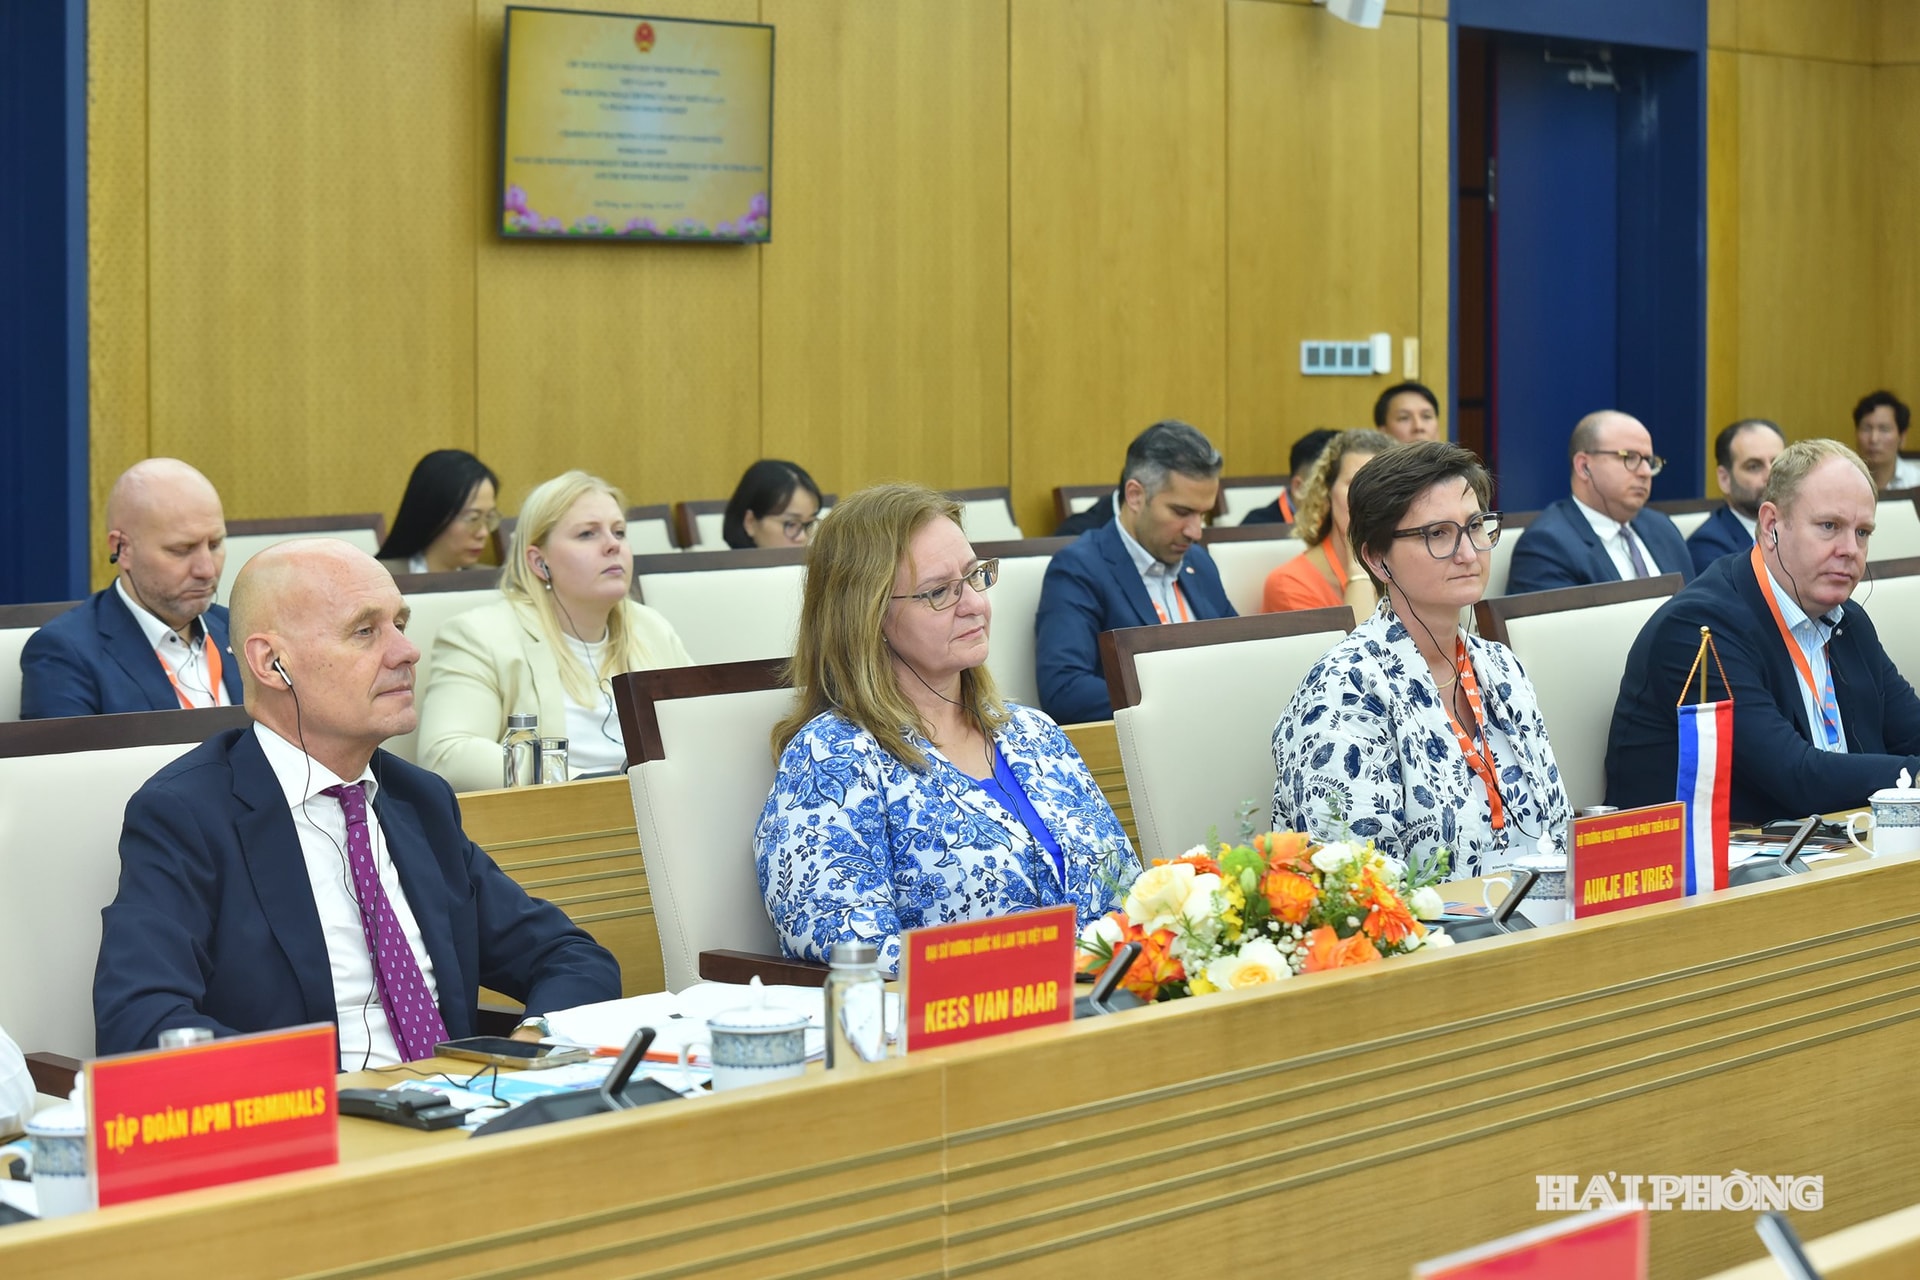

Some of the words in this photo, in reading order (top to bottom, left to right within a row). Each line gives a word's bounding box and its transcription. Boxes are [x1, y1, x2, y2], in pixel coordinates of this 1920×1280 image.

[1461, 670, 1472, 679] NL
[1463, 749, 1477, 758] NL
[1583, 874, 1621, 905] AUKJE
[1623, 870, 1639, 898] DE
[1640, 864, 1674, 894] VRIES
[924, 995, 970, 1034] KEES
[973, 988, 1009, 1025] VAN
[1011, 980, 1058, 1018] BAAR
[104, 1113, 139, 1155] TẬP
[141, 1105, 188, 1144] ĐOÀN
[191, 1101, 232, 1136] APM
[233, 1086, 326, 1129] TERMINALS
